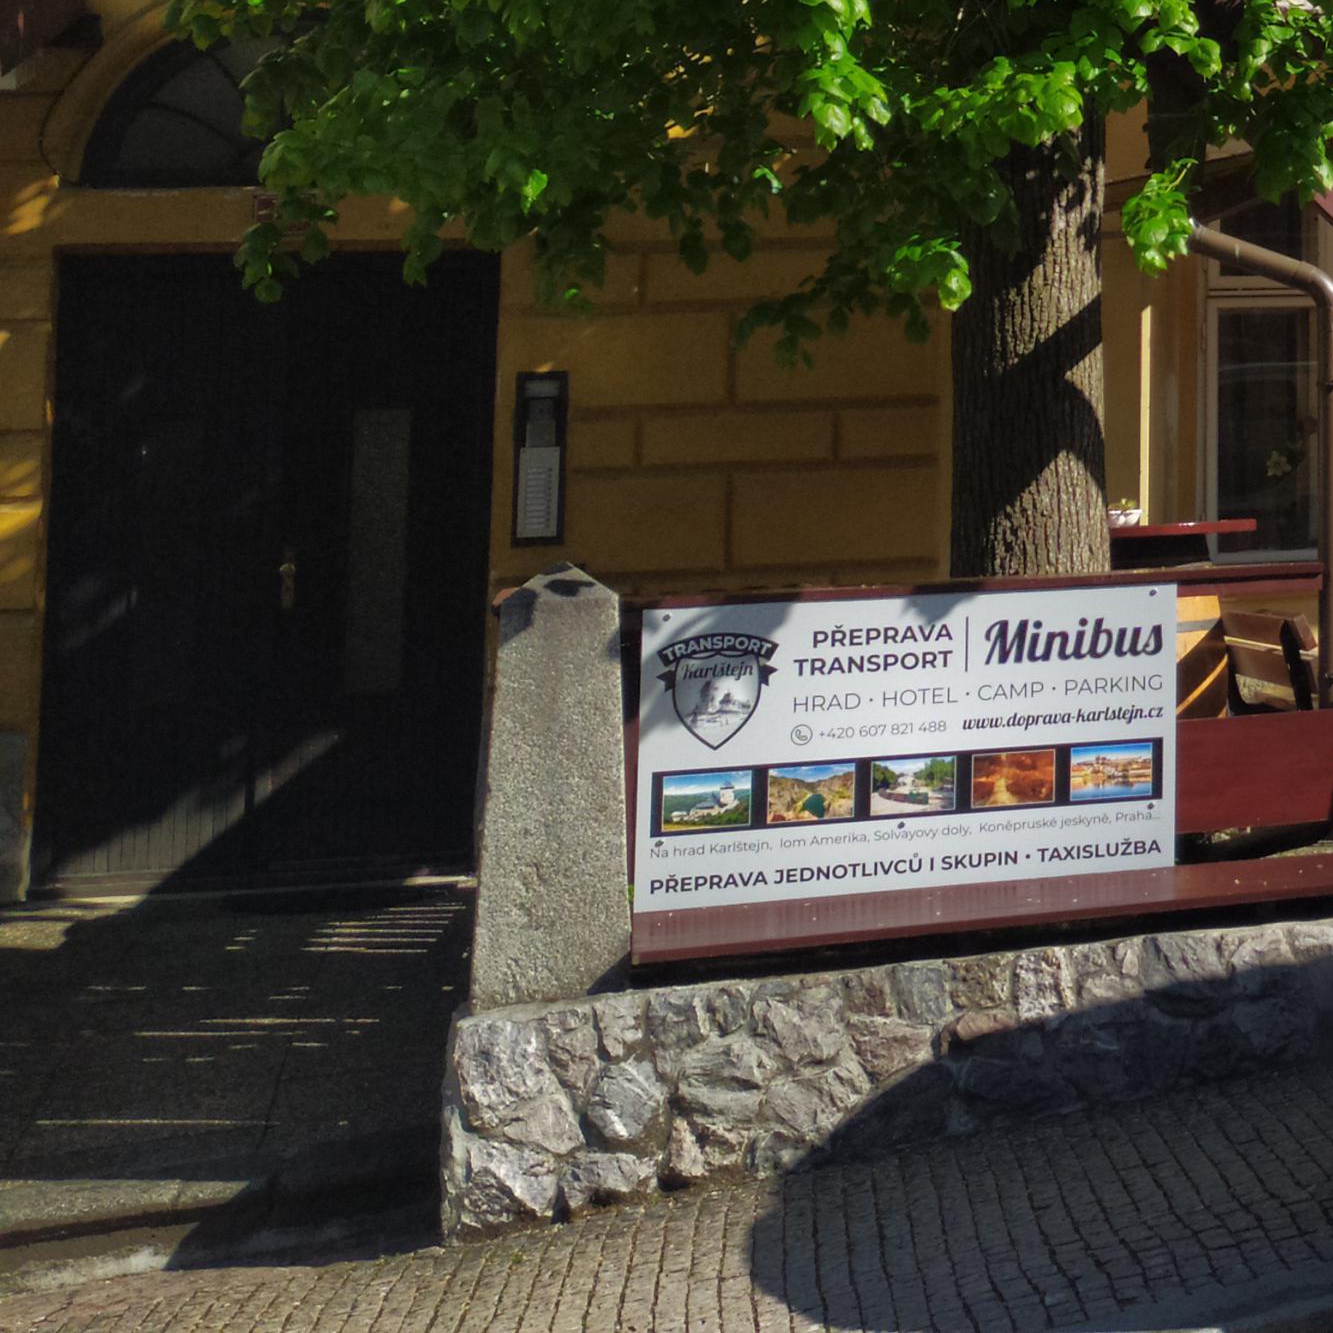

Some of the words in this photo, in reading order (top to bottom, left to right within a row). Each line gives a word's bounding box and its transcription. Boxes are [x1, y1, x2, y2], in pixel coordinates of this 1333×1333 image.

[662, 636, 773, 662] TRANSPORT
[812, 624, 953, 649] PŘEPRAVA
[984, 617, 1164, 666] Minibus
[679, 661, 754, 682] Karlštejn
[793, 650, 953, 677] TRANSPORT
[793, 692, 861, 713] HRAD
[882, 686, 958, 707] HOTEL
[978, 681, 1044, 702] CAMP
[1064, 674, 1163, 696] PARKING
[818, 726, 854, 741] +420
[859, 724, 886, 738] 607
[891, 722, 914, 736] 821
[918, 721, 947, 734] 488
[962, 704, 1164, 731] www.doprava-karlstejn.cz
[650, 847, 668, 859] Na
[673, 844, 705, 857] hrad
[710, 839, 773, 856] Karlštejn,
[780, 836, 806, 849] lom
[810, 831, 870, 846] Amerika,
[874, 826, 938, 842] Solvayovy
[942, 824, 972, 838] doly,
[979, 816, 1057, 834] Koněpruské
[1060, 813, 1112, 830] jeskyně,
[650, 871, 768, 895] PŘEPRAVA
[774, 852, 922, 885] JEDNOTLIVCŮ
[929, 857, 935, 872] I
[941, 850, 1018, 871] SKUPIN
[1037, 838, 1162, 863] TAXISLUŽBA
